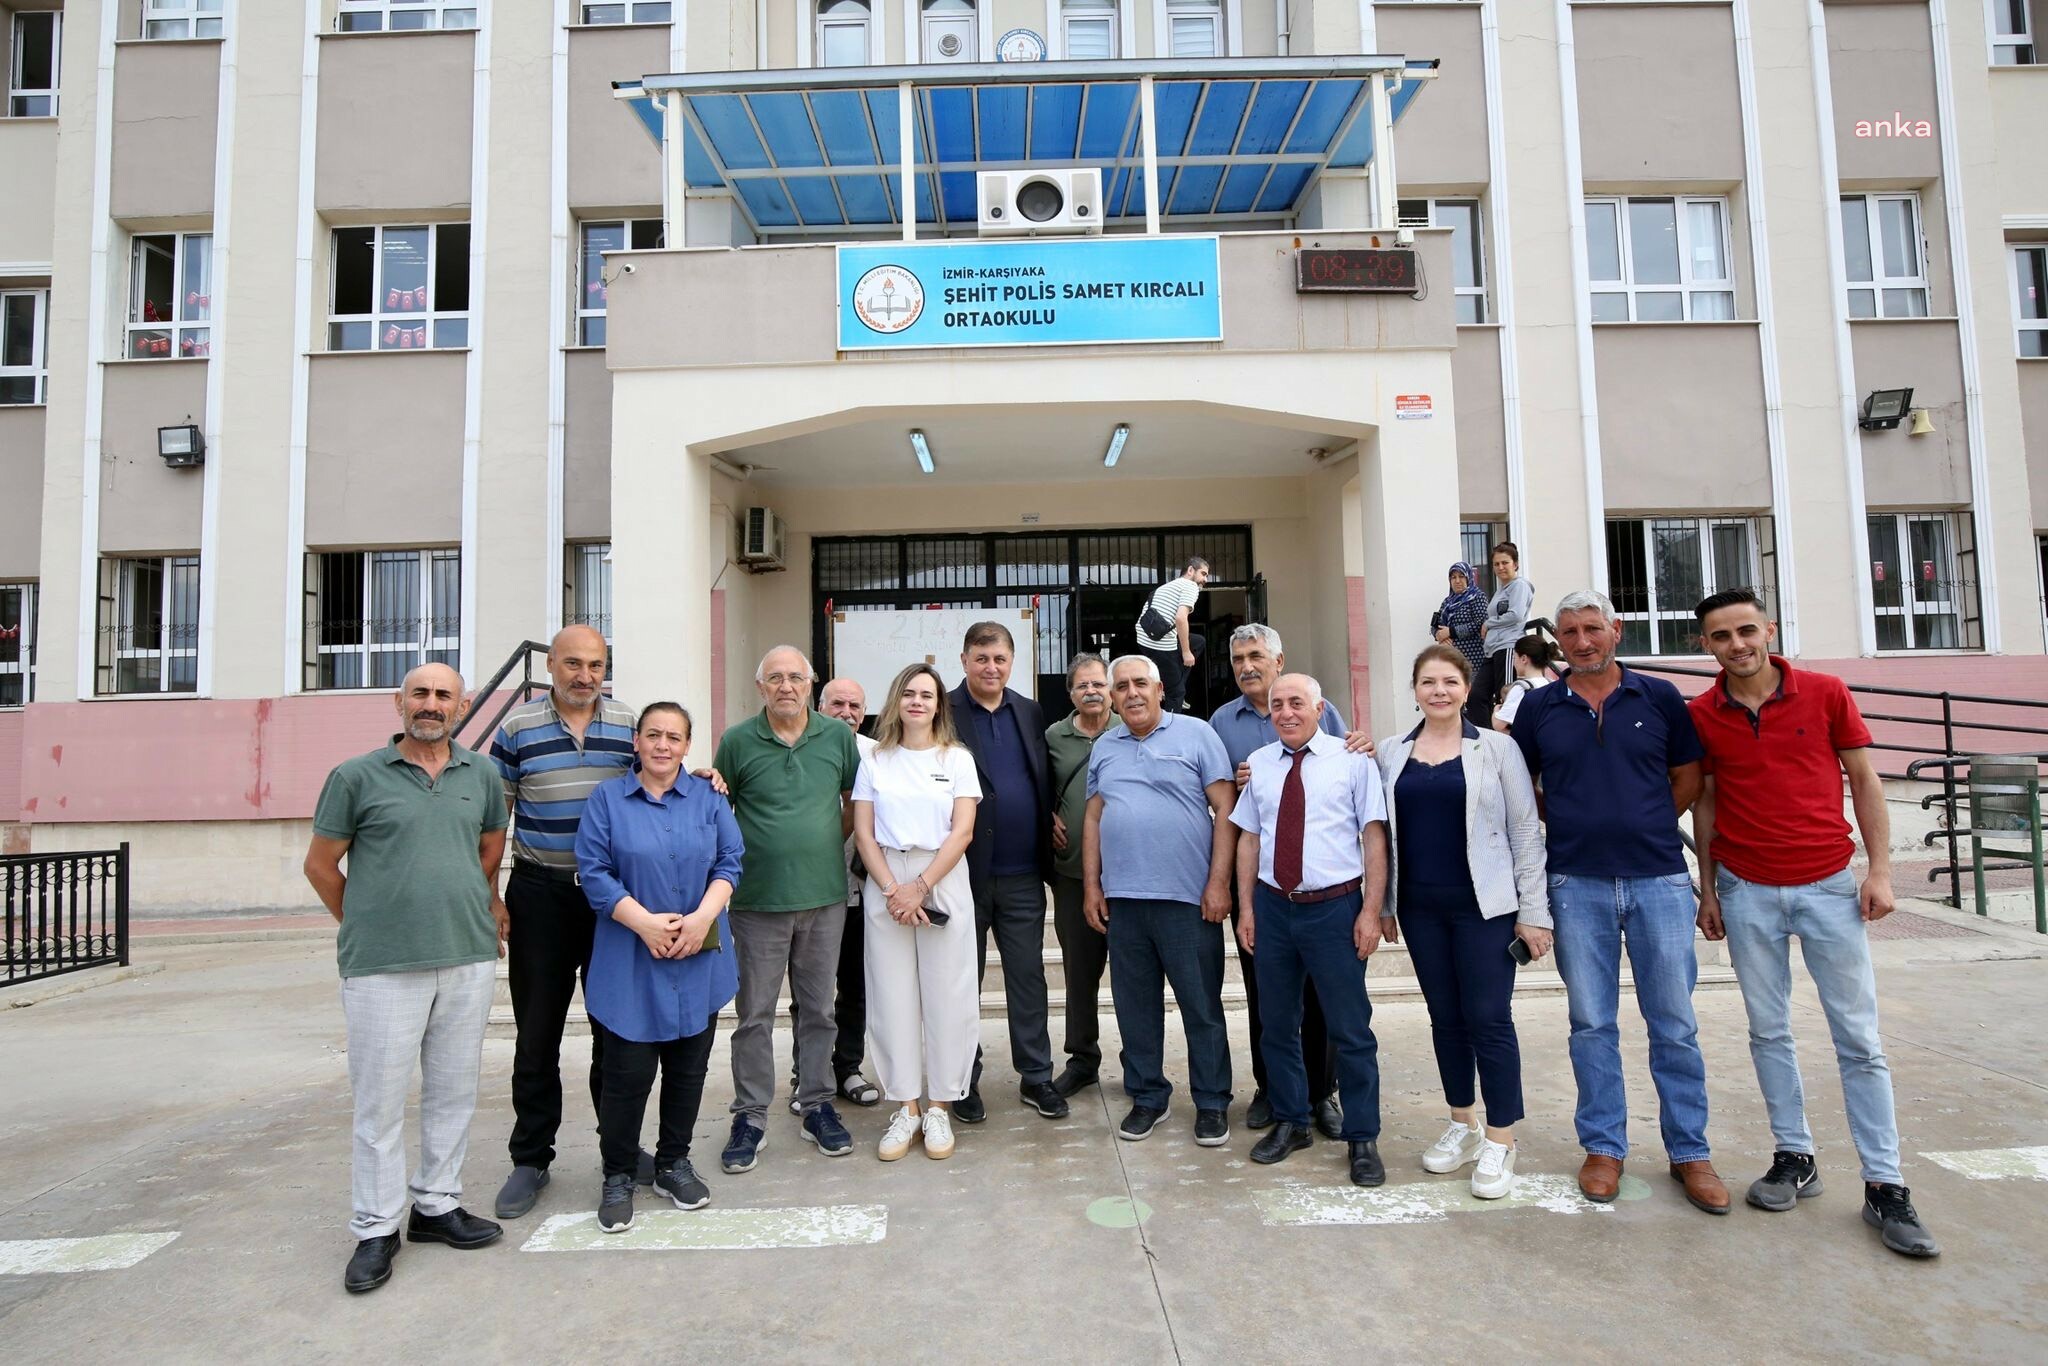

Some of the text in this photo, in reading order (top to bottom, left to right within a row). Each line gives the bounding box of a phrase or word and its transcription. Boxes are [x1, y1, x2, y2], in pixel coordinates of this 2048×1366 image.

[943, 266, 1045, 279] İZMİR-KARŞIYAKA
[1311, 255, 1405, 281] 08:39
[944, 280, 1204, 305] ŞEHİT POLİS SAMET KIRCALI
[944, 309, 1055, 327] ORTAOKULU
